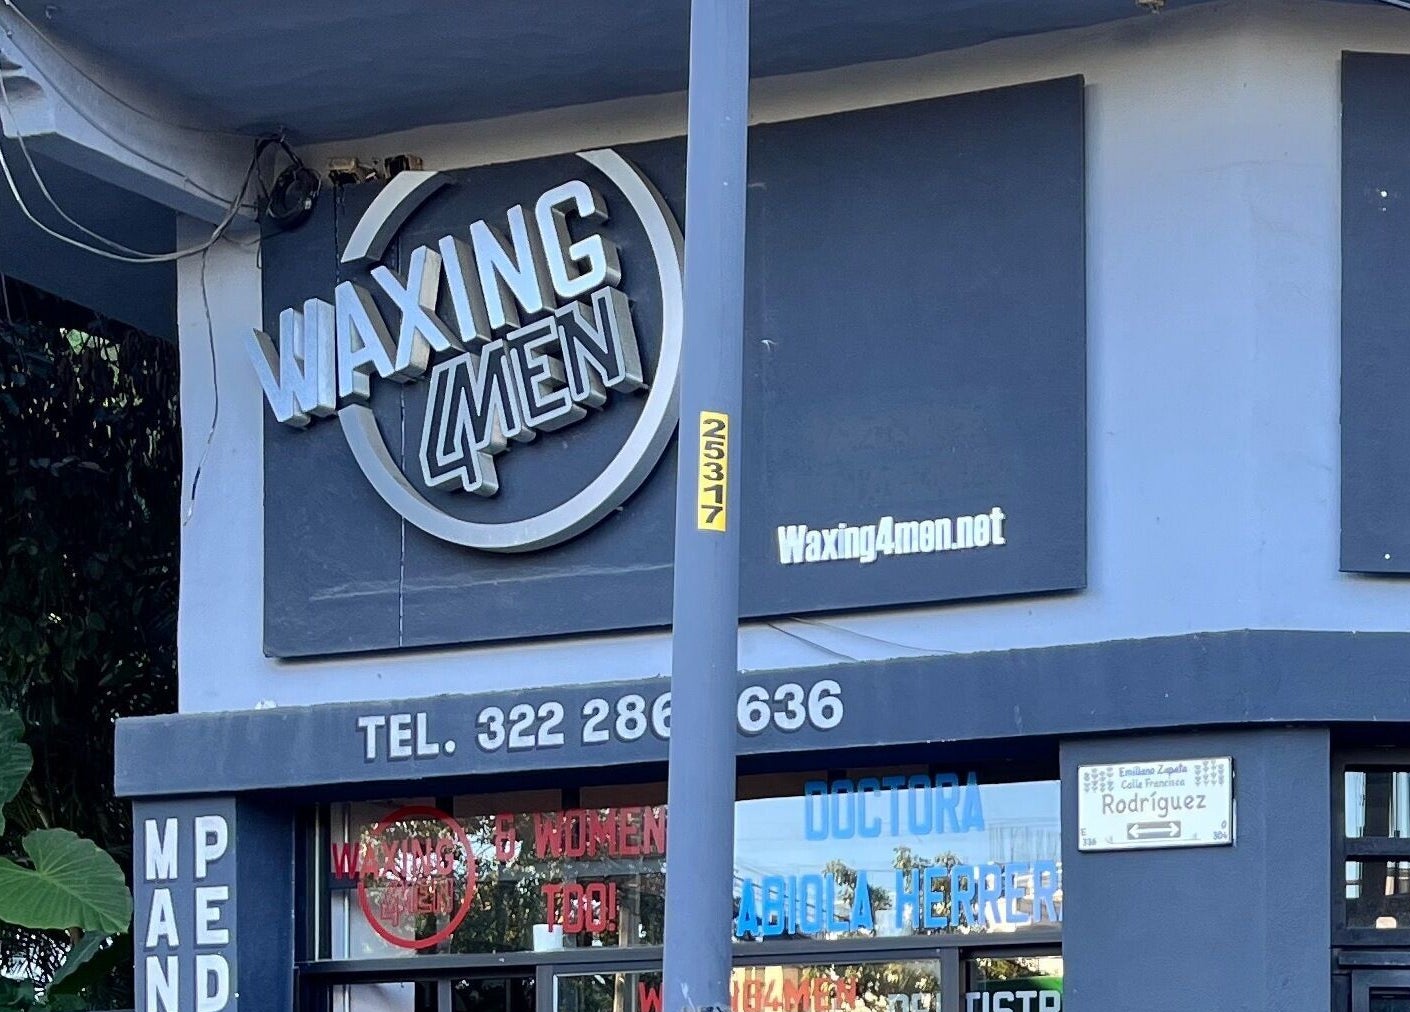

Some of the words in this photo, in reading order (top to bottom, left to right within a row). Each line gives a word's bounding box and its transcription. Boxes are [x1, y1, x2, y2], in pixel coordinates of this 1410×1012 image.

[246, 179, 622, 428] WAXING
[417, 285, 650, 497] 4MEN
[702, 418, 725, 523] 25317
[779, 507, 1005, 564] Waxing4men.net
[358, 714, 456, 760] TEL.
[477, 702, 564, 751] 322
[1119, 766, 1155, 778] Emiliano
[1157, 763, 1188, 777] Zapata
[1121, 780, 1142, 790] Calle
[534, 808, 666, 858] WOMEN
[804, 771, 985, 841] DOCTORA
[1102, 791, 1207, 818] Rodríguez
[332, 840, 455, 880] WAXING
[541, 882, 616, 933] TOO!
[736, 870, 874, 937] ABIOLA
[894, 860, 1062, 930] HERRER
